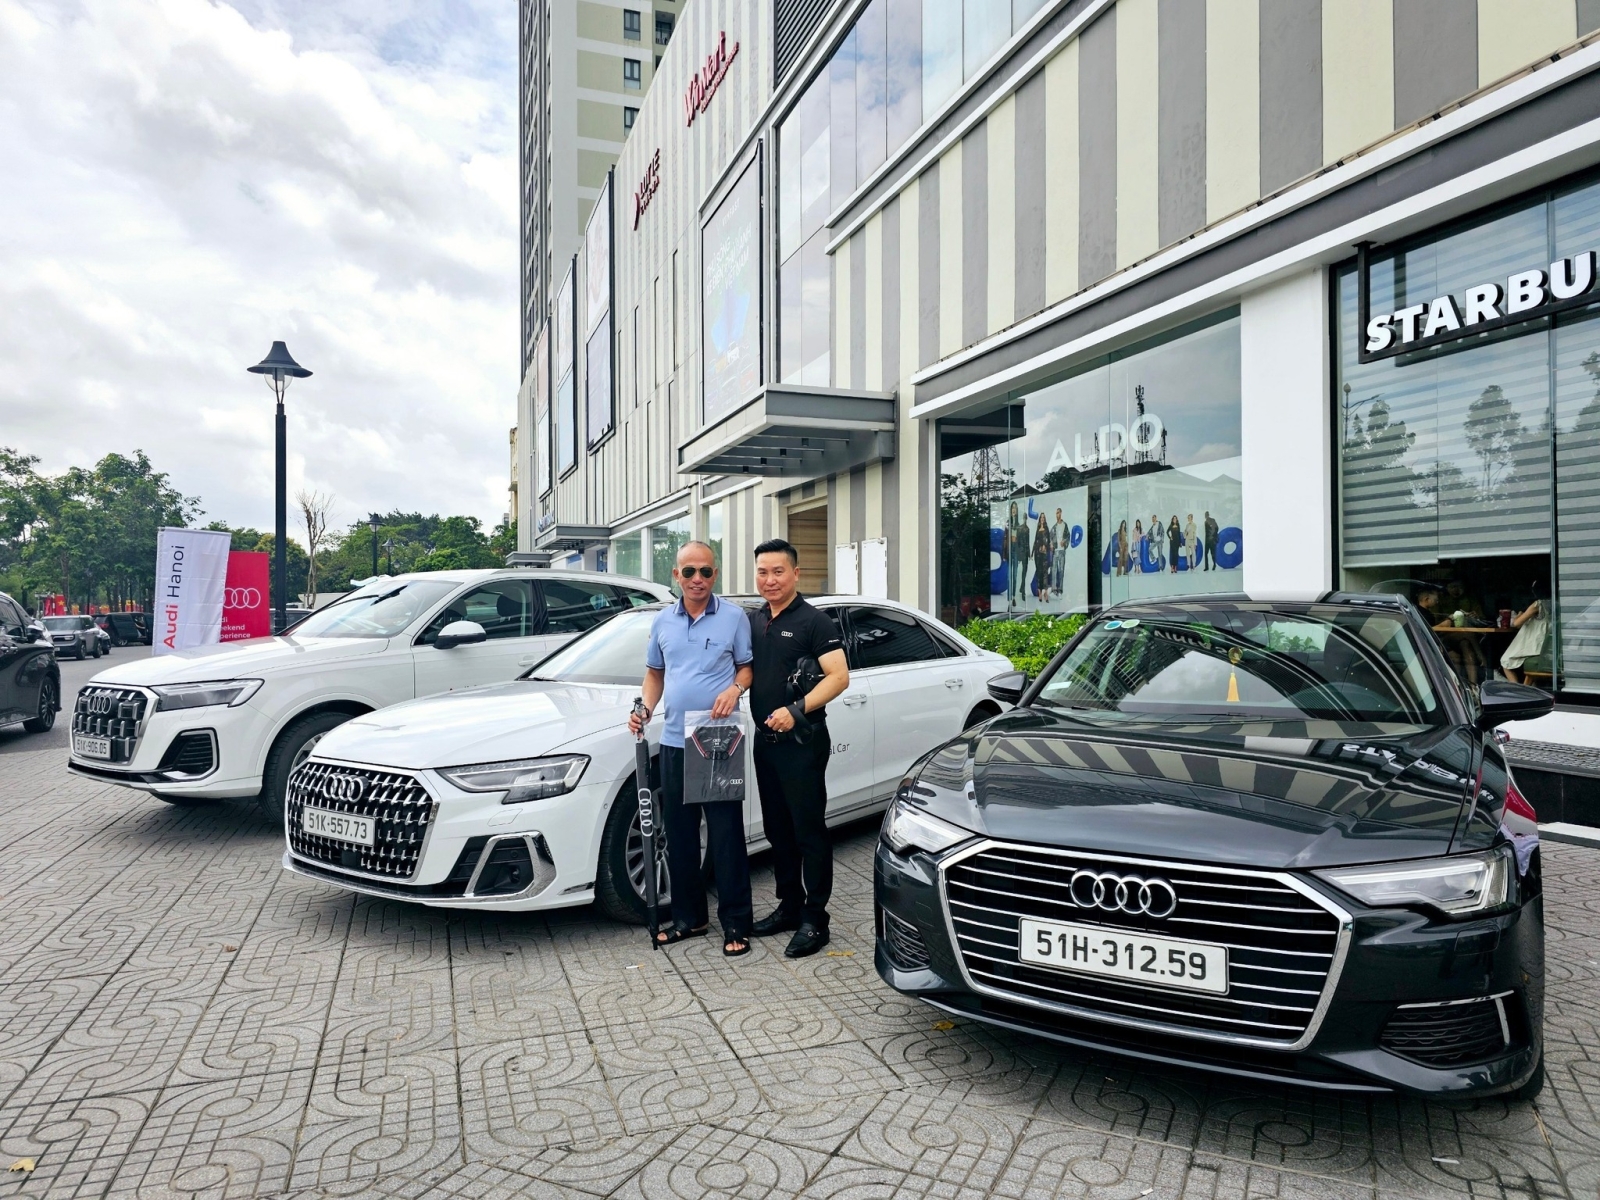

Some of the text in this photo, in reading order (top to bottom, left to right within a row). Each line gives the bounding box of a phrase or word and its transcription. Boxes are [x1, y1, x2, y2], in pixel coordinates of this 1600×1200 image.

[1365, 251, 1596, 352] STARBU
[1045, 413, 1163, 474] ALDO
[163, 545, 185, 649] Audi Hanoi
[836, 743, 850, 753] Car
[308, 812, 367, 839] 51K-557.73
[1036, 929, 1207, 981] 51H-312.59
